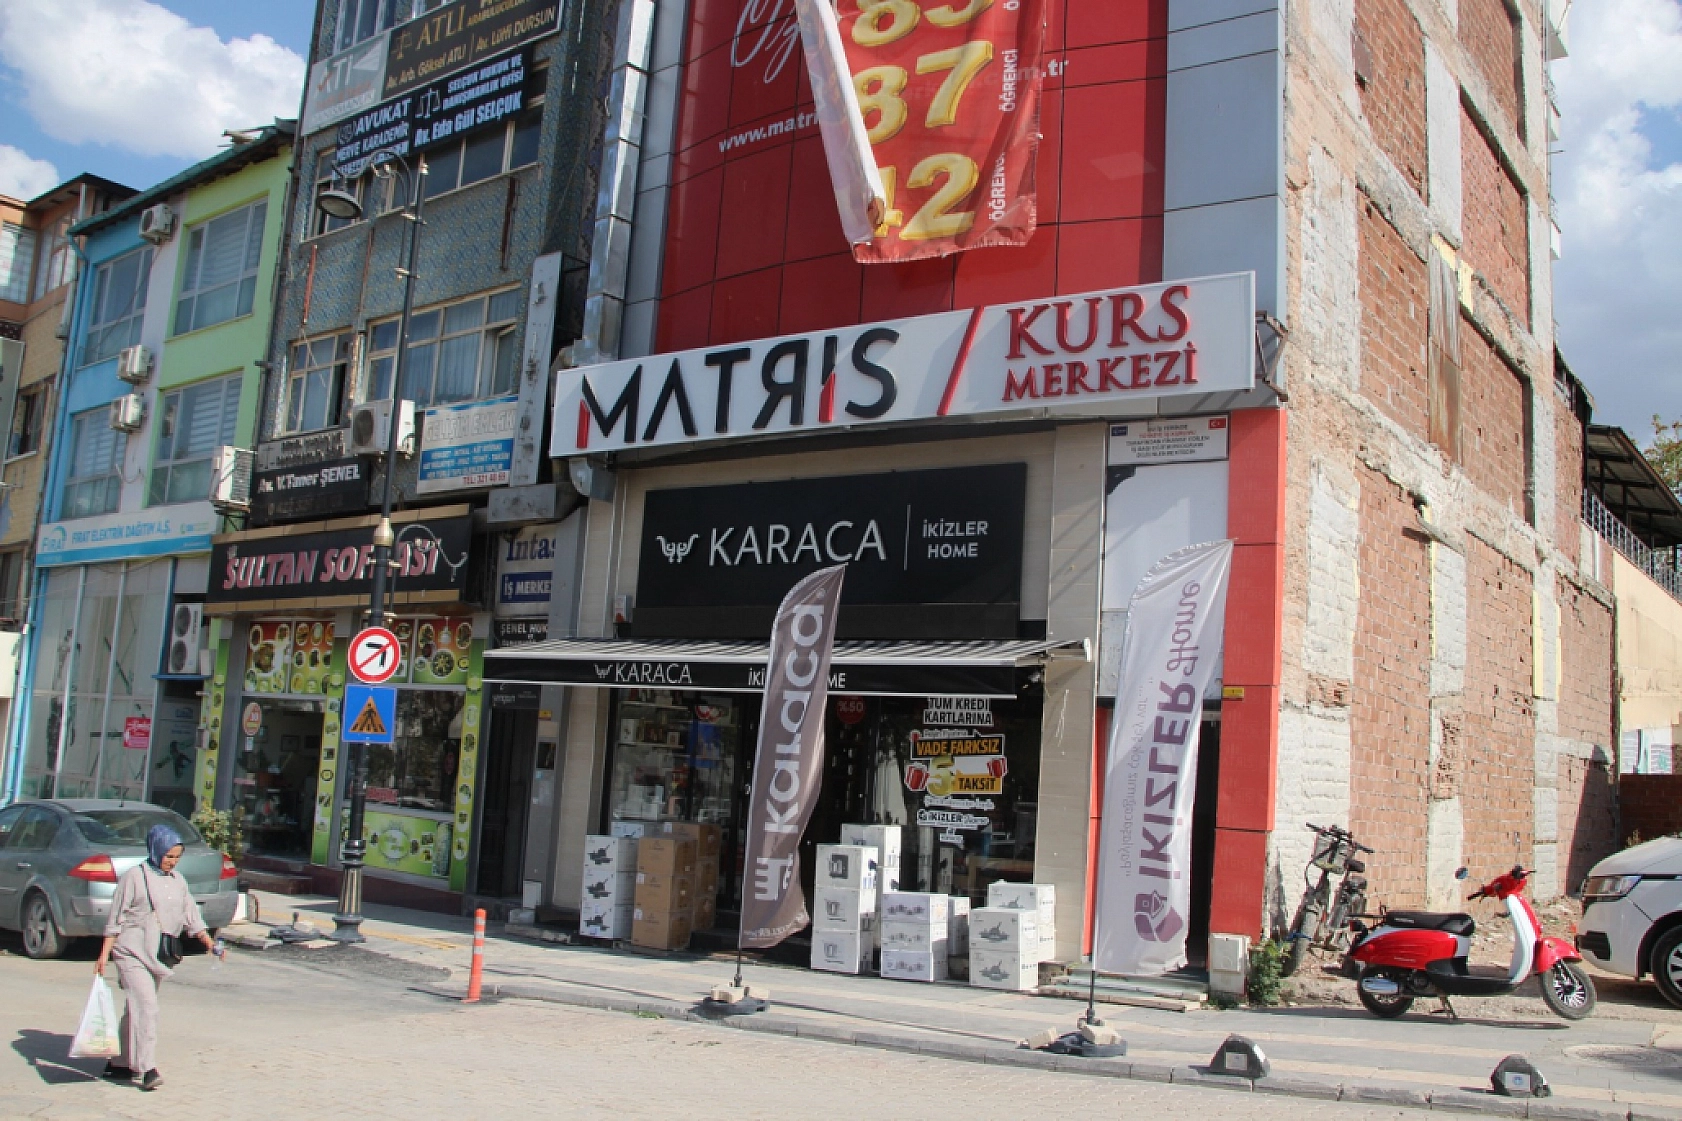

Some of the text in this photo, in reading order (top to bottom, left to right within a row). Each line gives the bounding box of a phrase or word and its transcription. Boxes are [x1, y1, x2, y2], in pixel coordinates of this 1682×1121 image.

[417, 4, 466, 50] ATLI
[513, 6, 557, 37] DURSUN
[998, 48, 1019, 112] ÖĞRENCİ
[355, 97, 413, 137] AVUKAT
[476, 90, 523, 124] SELÇUK
[719, 112, 820, 153] www.matri
[1005, 285, 1192, 361] KURS
[1001, 340, 1199, 402] MERKEZİ
[320, 463, 361, 488] ŞENEL
[709, 519, 887, 567] KARACA
[922, 517, 989, 539] İKİZLER
[222, 538, 443, 590] SULTAN SOFASI
[927, 542, 979, 559] HOME
[614, 663, 692, 684] KARACA
[923, 710, 993, 725] KARTLARINA
[916, 738, 1000, 755] VADE FARKSIZ
[957, 775, 996, 790] TAKSİT
